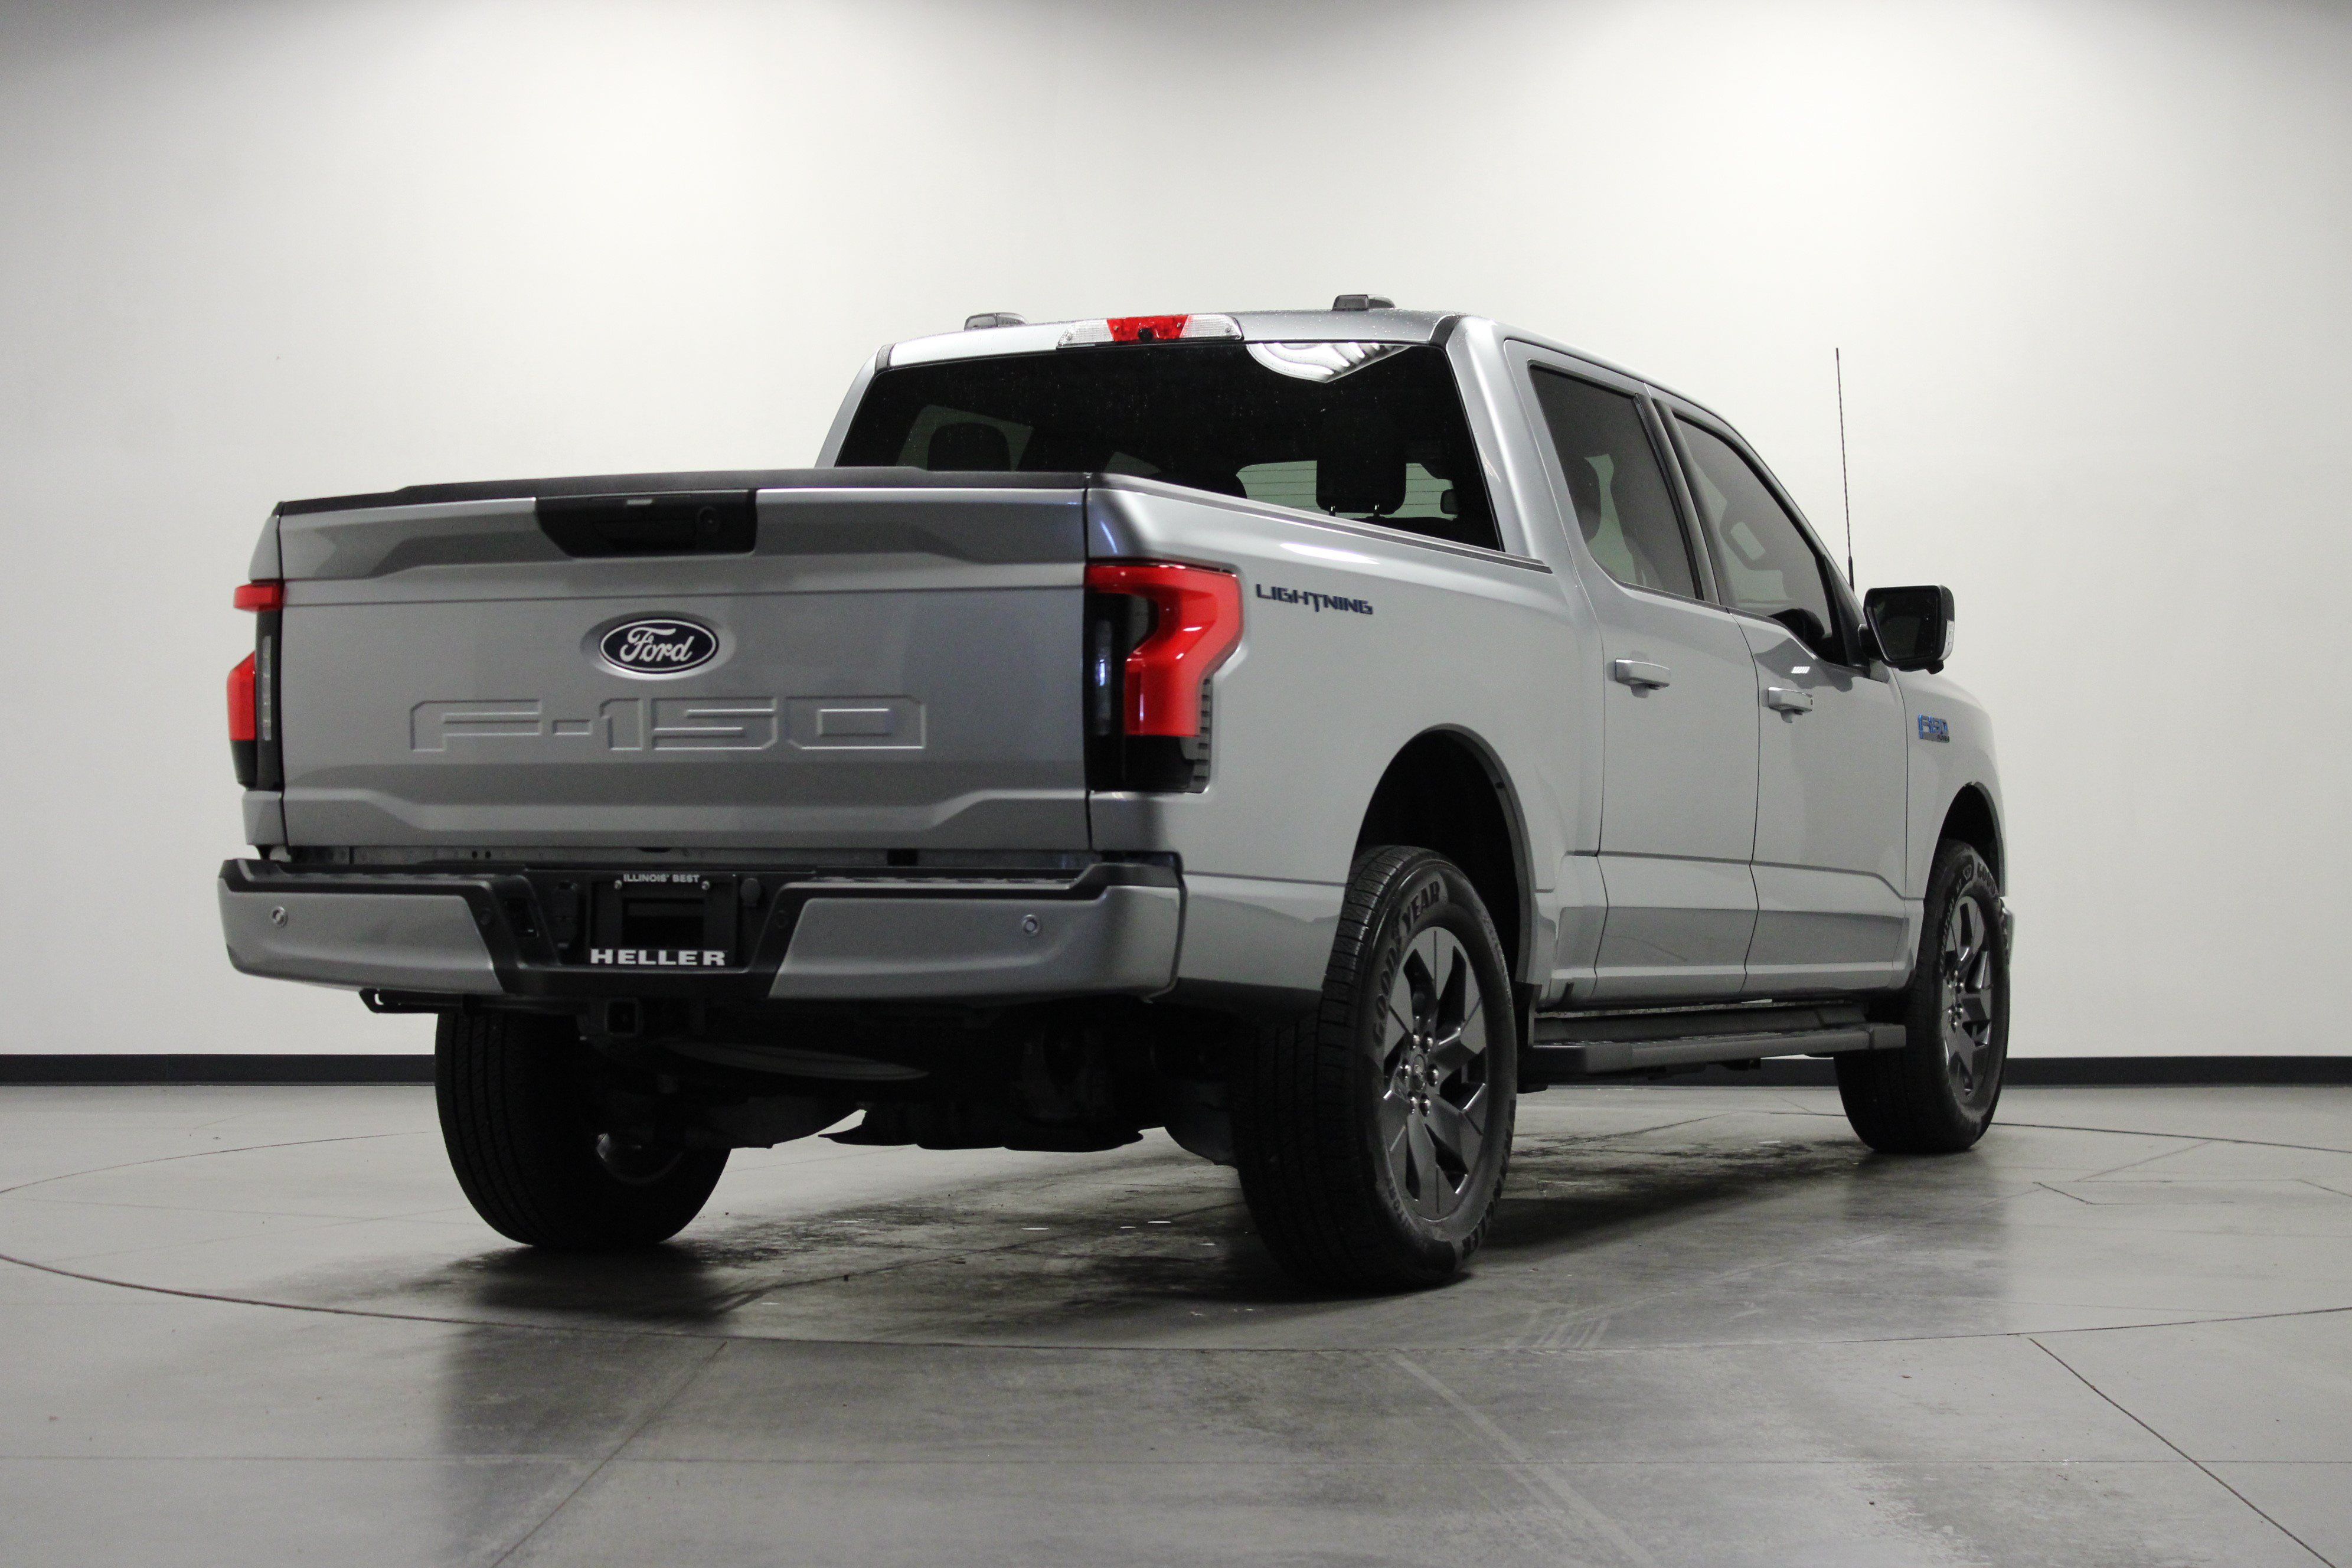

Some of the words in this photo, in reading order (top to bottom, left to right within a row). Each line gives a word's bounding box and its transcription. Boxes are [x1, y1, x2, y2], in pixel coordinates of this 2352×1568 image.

[1256, 584, 1373, 615] LIGHTNING
[620, 626, 695, 662] Ford
[410, 697, 926, 751] F-150
[672, 874, 700, 883] BEST
[590, 949, 726, 966] HELLER
